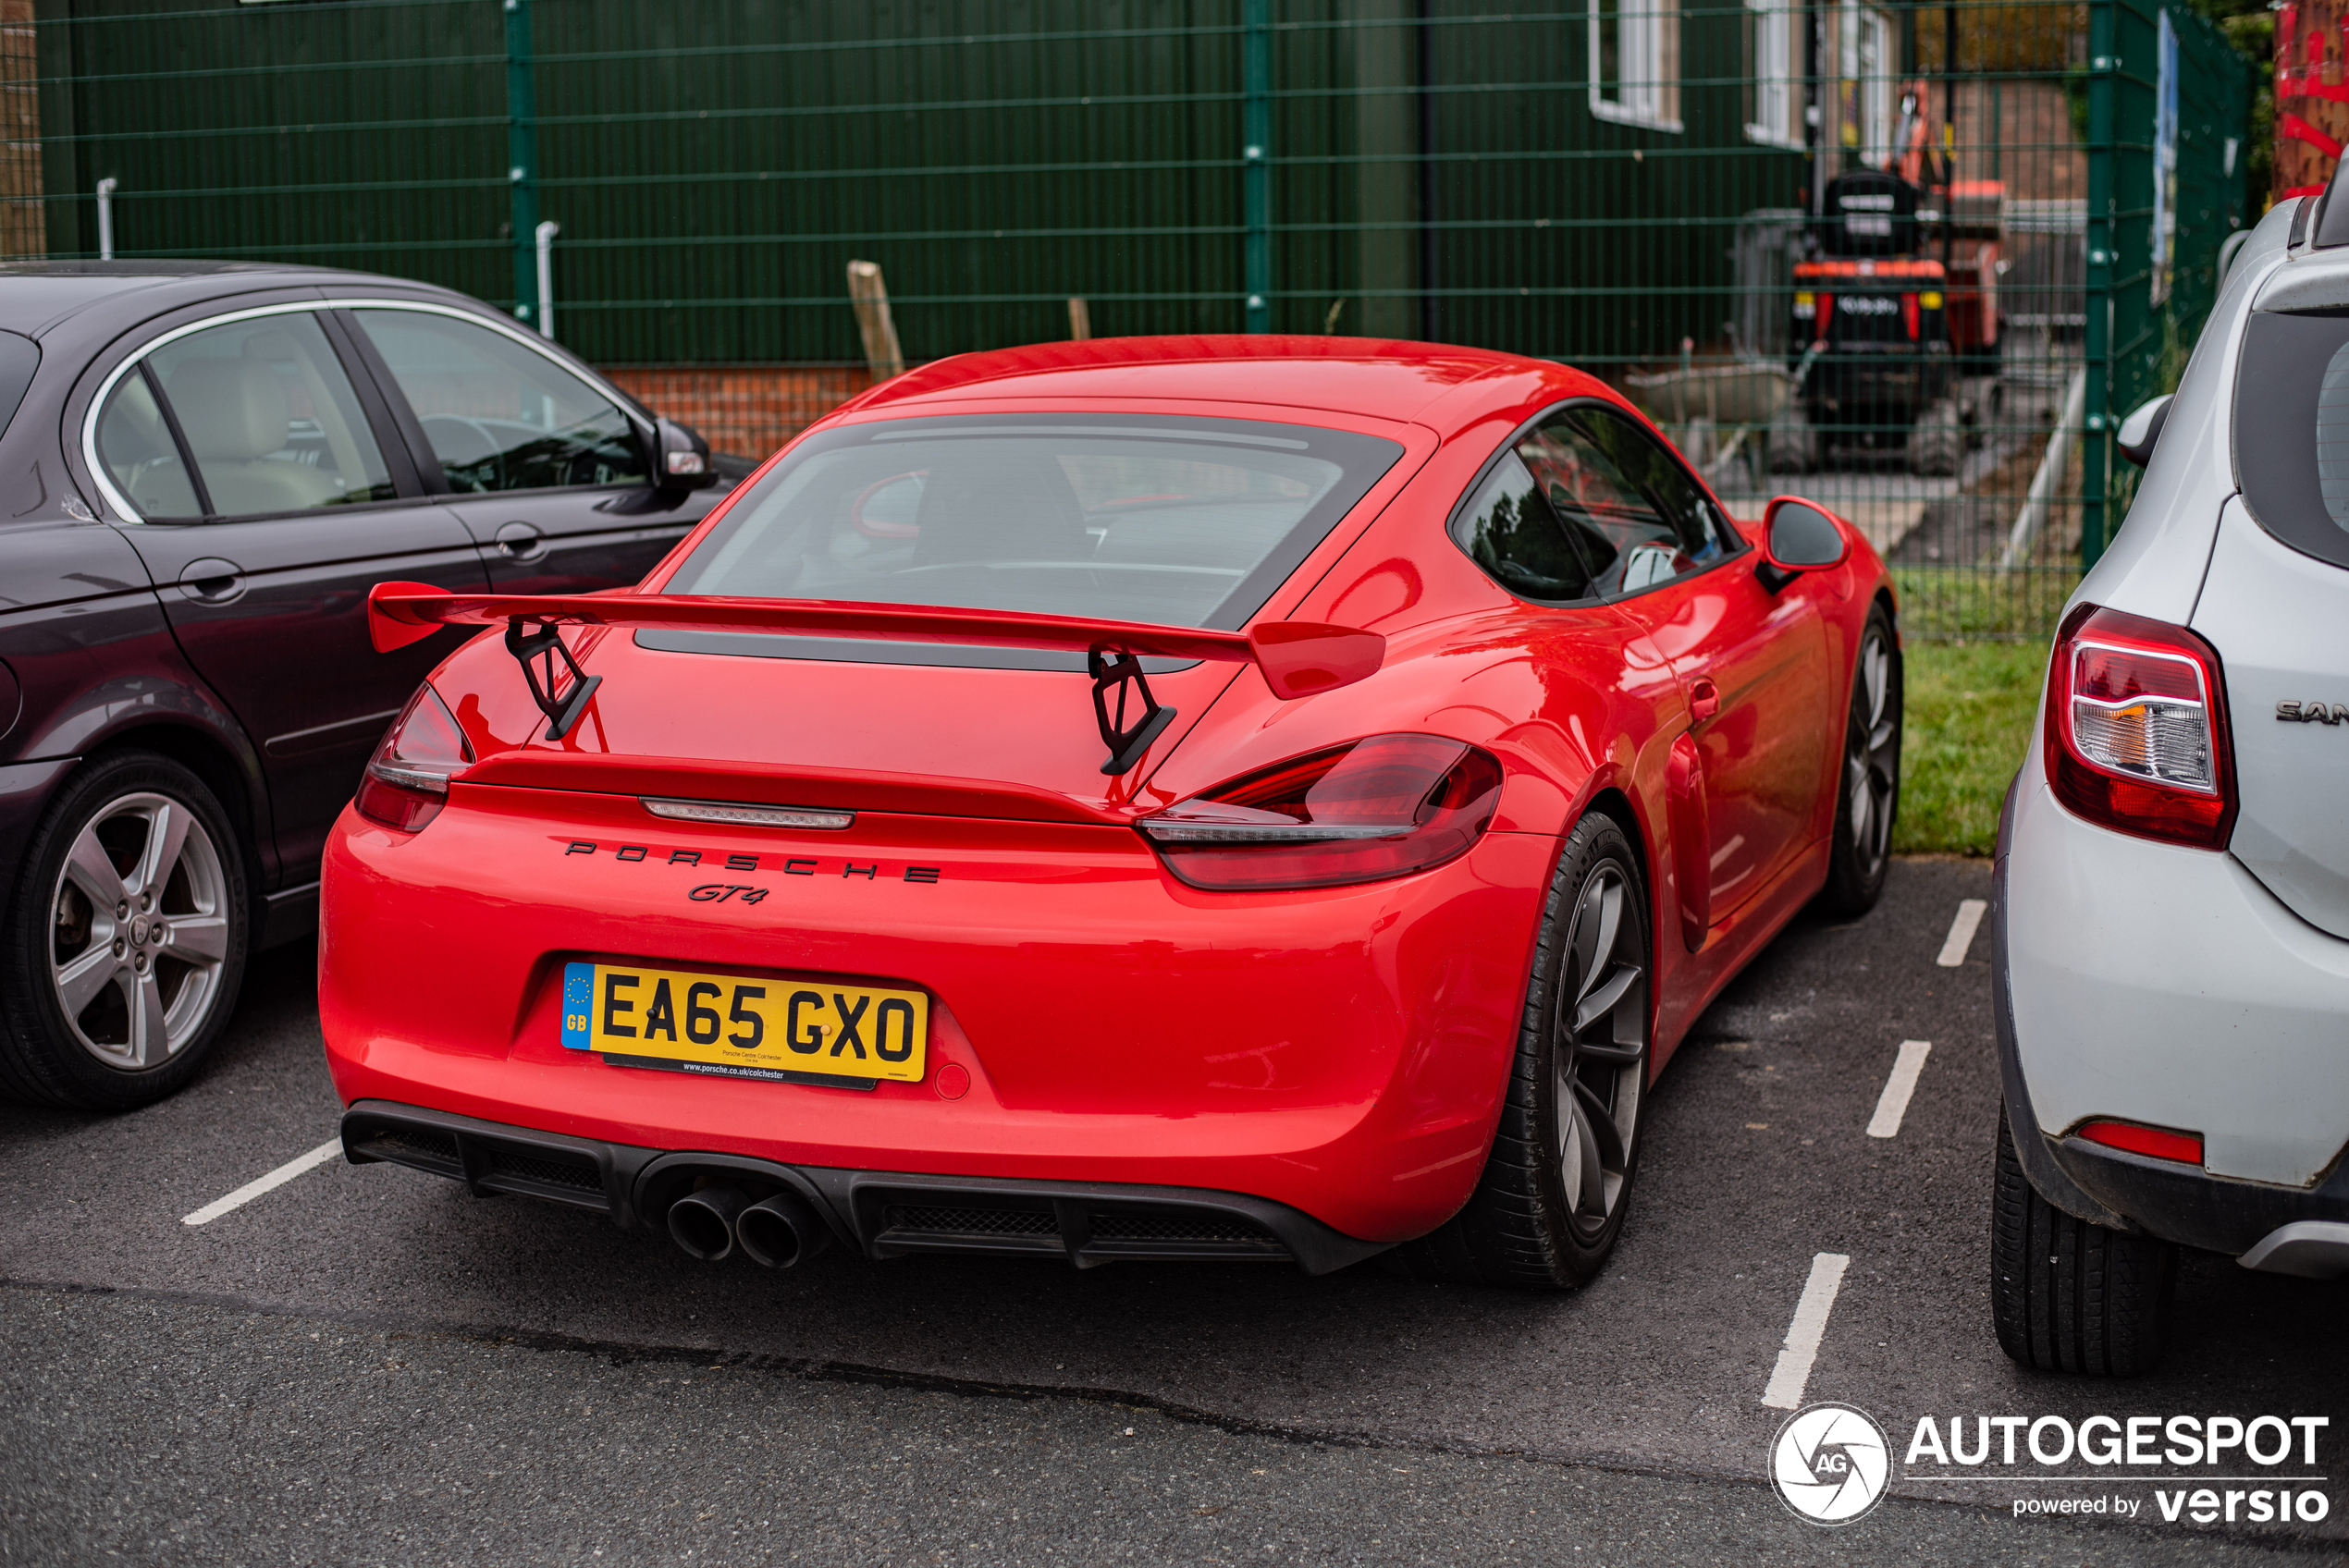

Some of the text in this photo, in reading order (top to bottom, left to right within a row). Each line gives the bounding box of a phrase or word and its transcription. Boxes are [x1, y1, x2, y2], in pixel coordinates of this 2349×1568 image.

[565, 841, 941, 883] PORSCHE
[687, 883, 769, 905] GT4
[566, 1013, 587, 1032] GB
[603, 973, 915, 1063] EA65 GXO
[683, 1063, 784, 1079] www.porsche.co.uk/colchester
